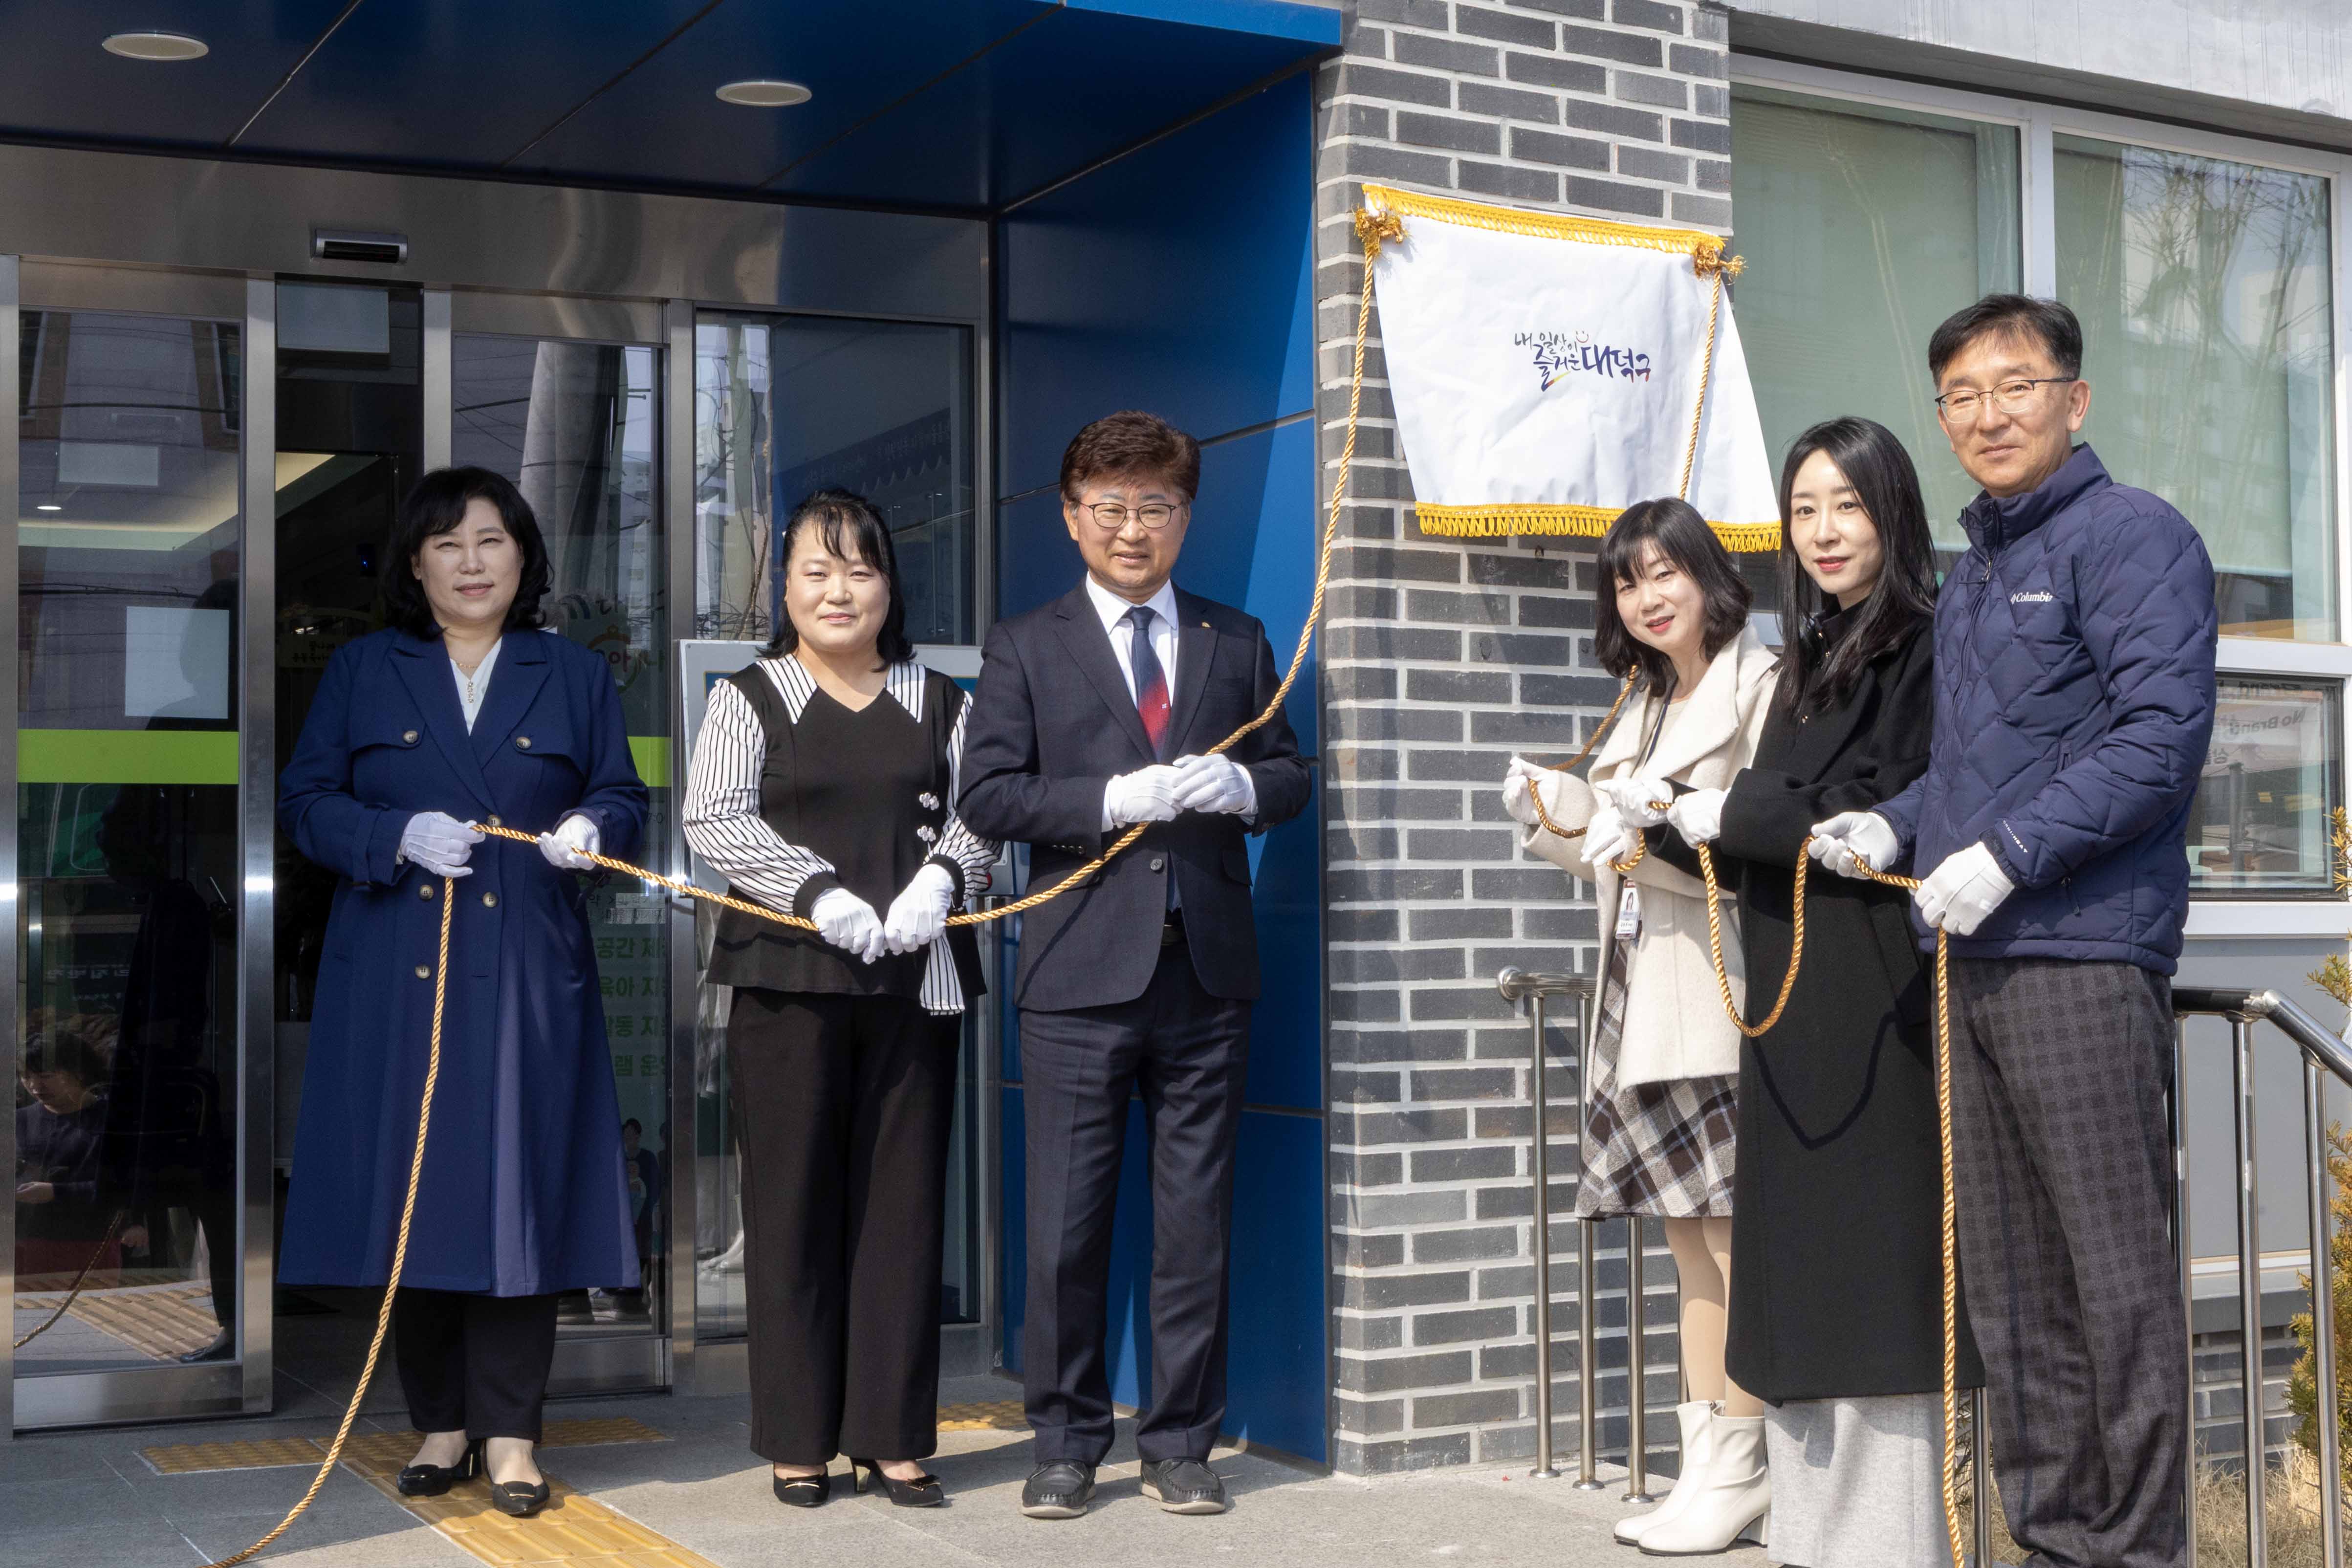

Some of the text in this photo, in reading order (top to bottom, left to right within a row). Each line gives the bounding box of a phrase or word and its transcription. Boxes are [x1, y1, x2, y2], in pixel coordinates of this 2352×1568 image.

[1514, 331, 1578, 354] 내 일상이
[1533, 344, 1652, 392] 즐거운 대덕구
[597, 936, 666, 959] 공간 제
[641, 977, 666, 998] 지
[641, 1015, 666, 1038] 지
[640, 1054, 666, 1077] 운
